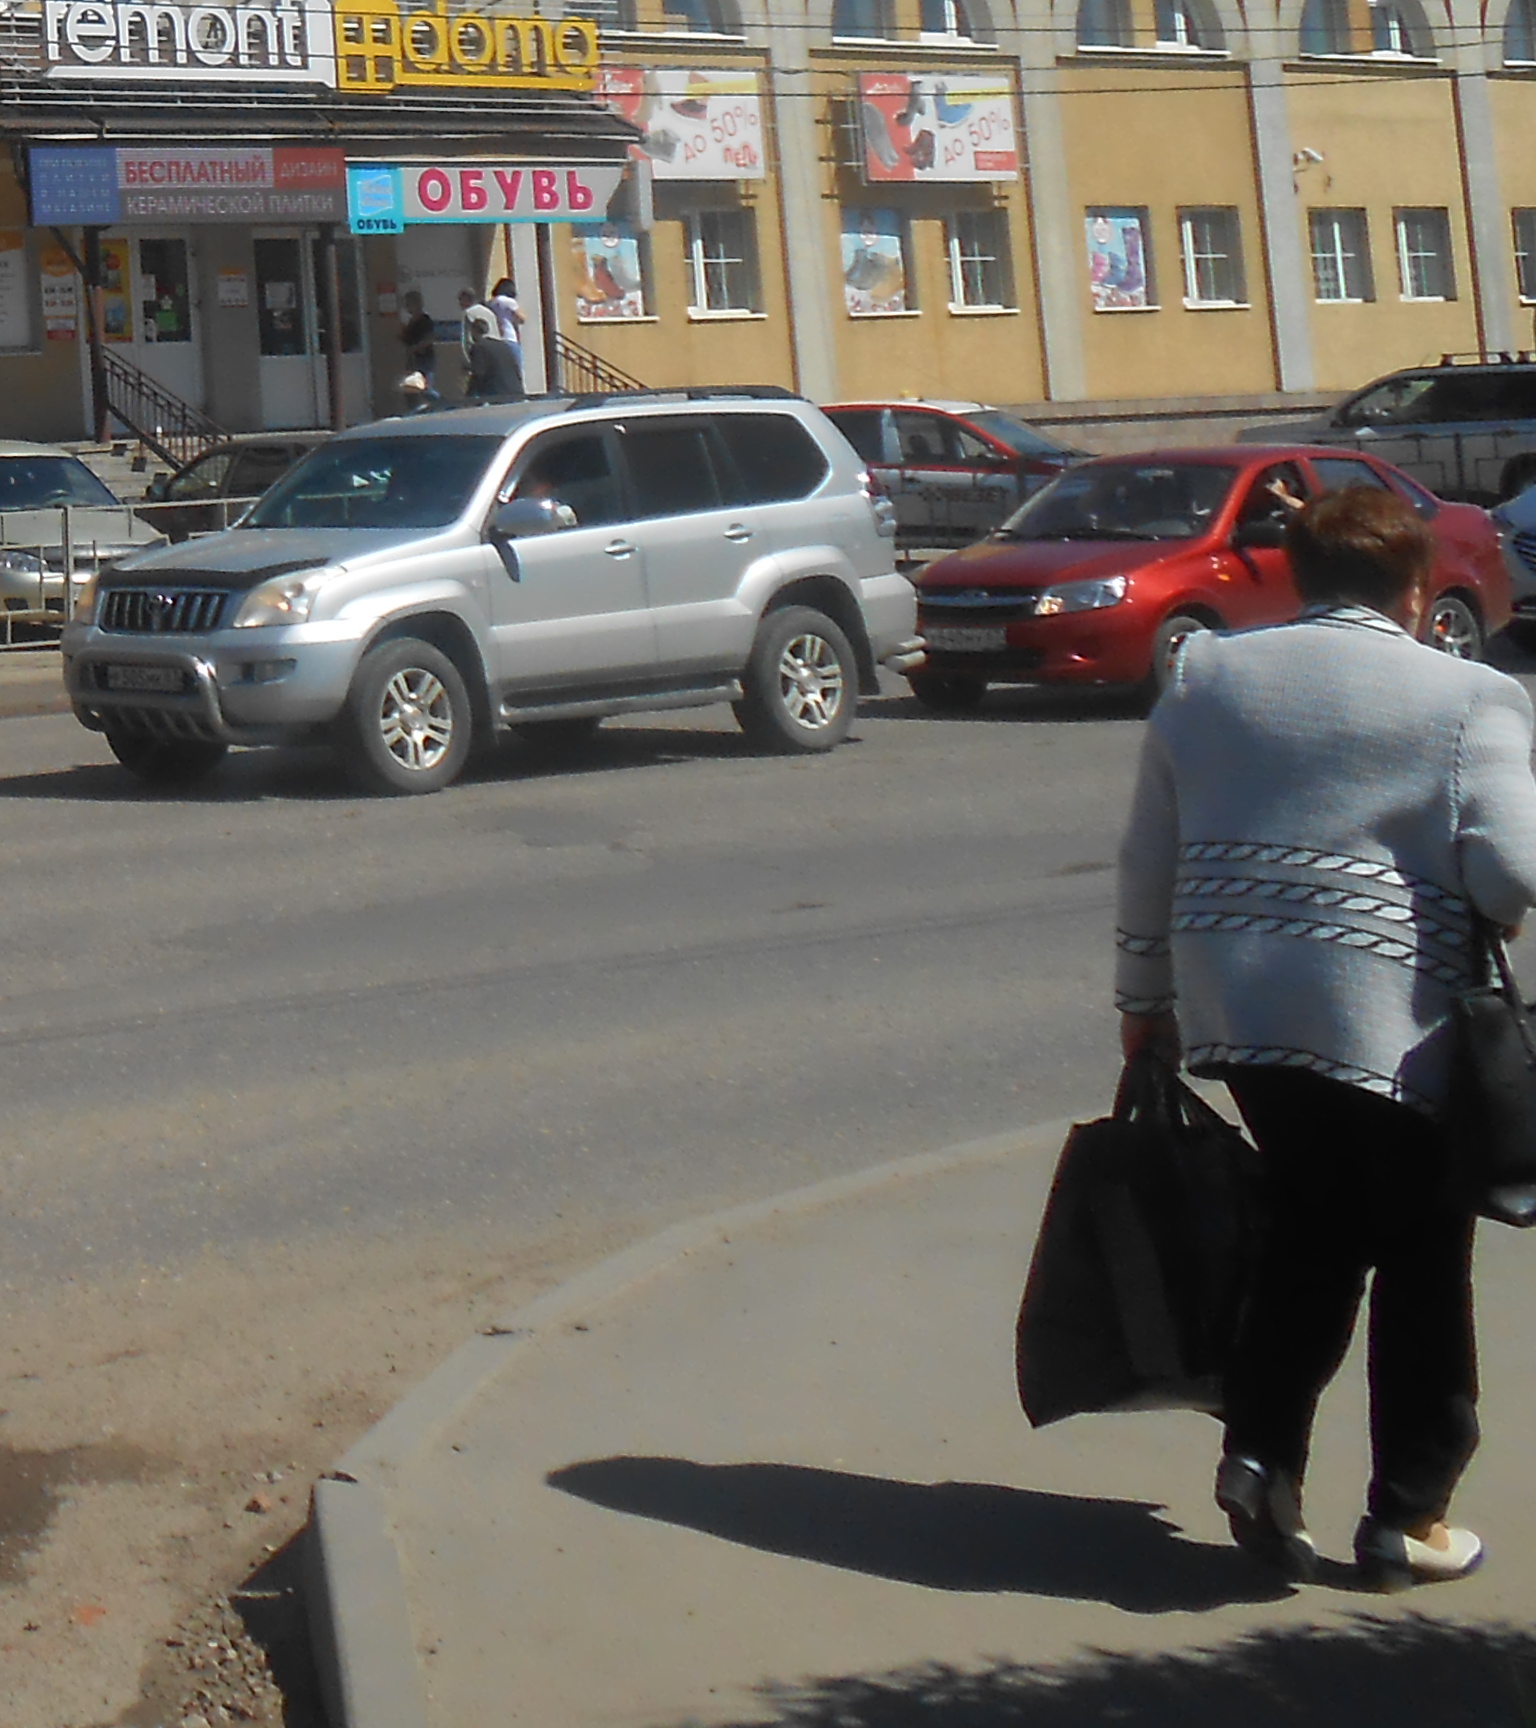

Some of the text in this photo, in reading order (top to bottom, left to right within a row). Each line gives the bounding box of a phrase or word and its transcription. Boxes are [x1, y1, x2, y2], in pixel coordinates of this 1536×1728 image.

[683, 133, 708, 164] ДО
[710, 104, 760, 144] 50%
[943, 138, 965, 168] ДО
[968, 107, 1011, 148] 50%
[125, 155, 267, 184] БЕСПЛАТНЫЙ
[127, 191, 265, 215] КЕРАМИЧЕСКОЙ
[268, 193, 335, 213] ПЛИТКИ
[416, 167, 595, 213] ОБУВЬ
[356, 218, 398, 231] ОБУВЬ
